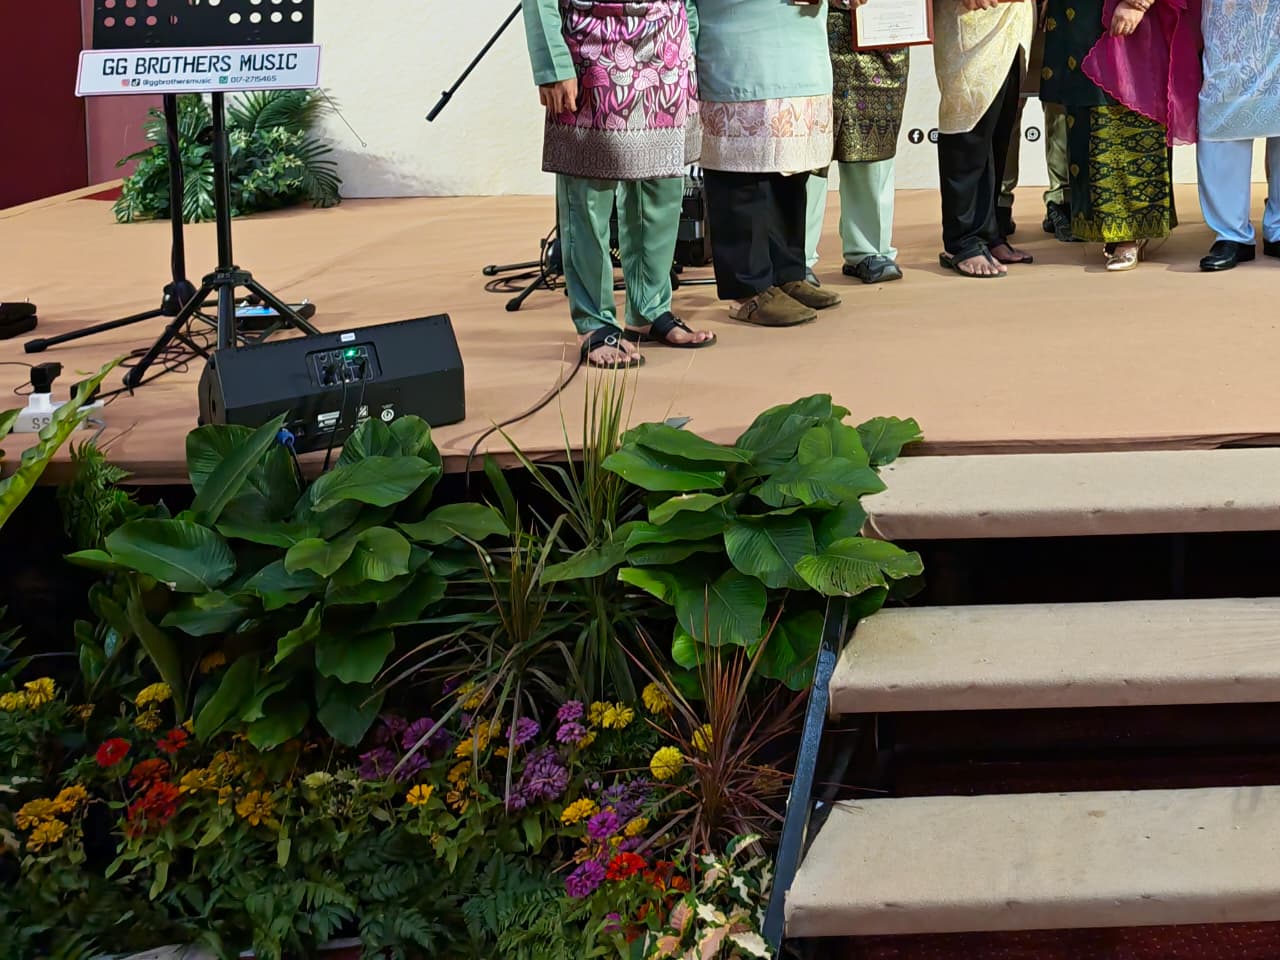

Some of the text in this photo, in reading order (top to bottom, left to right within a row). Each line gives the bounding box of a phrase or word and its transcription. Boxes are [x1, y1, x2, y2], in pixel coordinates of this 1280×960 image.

[102, 53, 298, 76] GG BROTHERS MUSIC
[31, 417, 50, 430] SS
